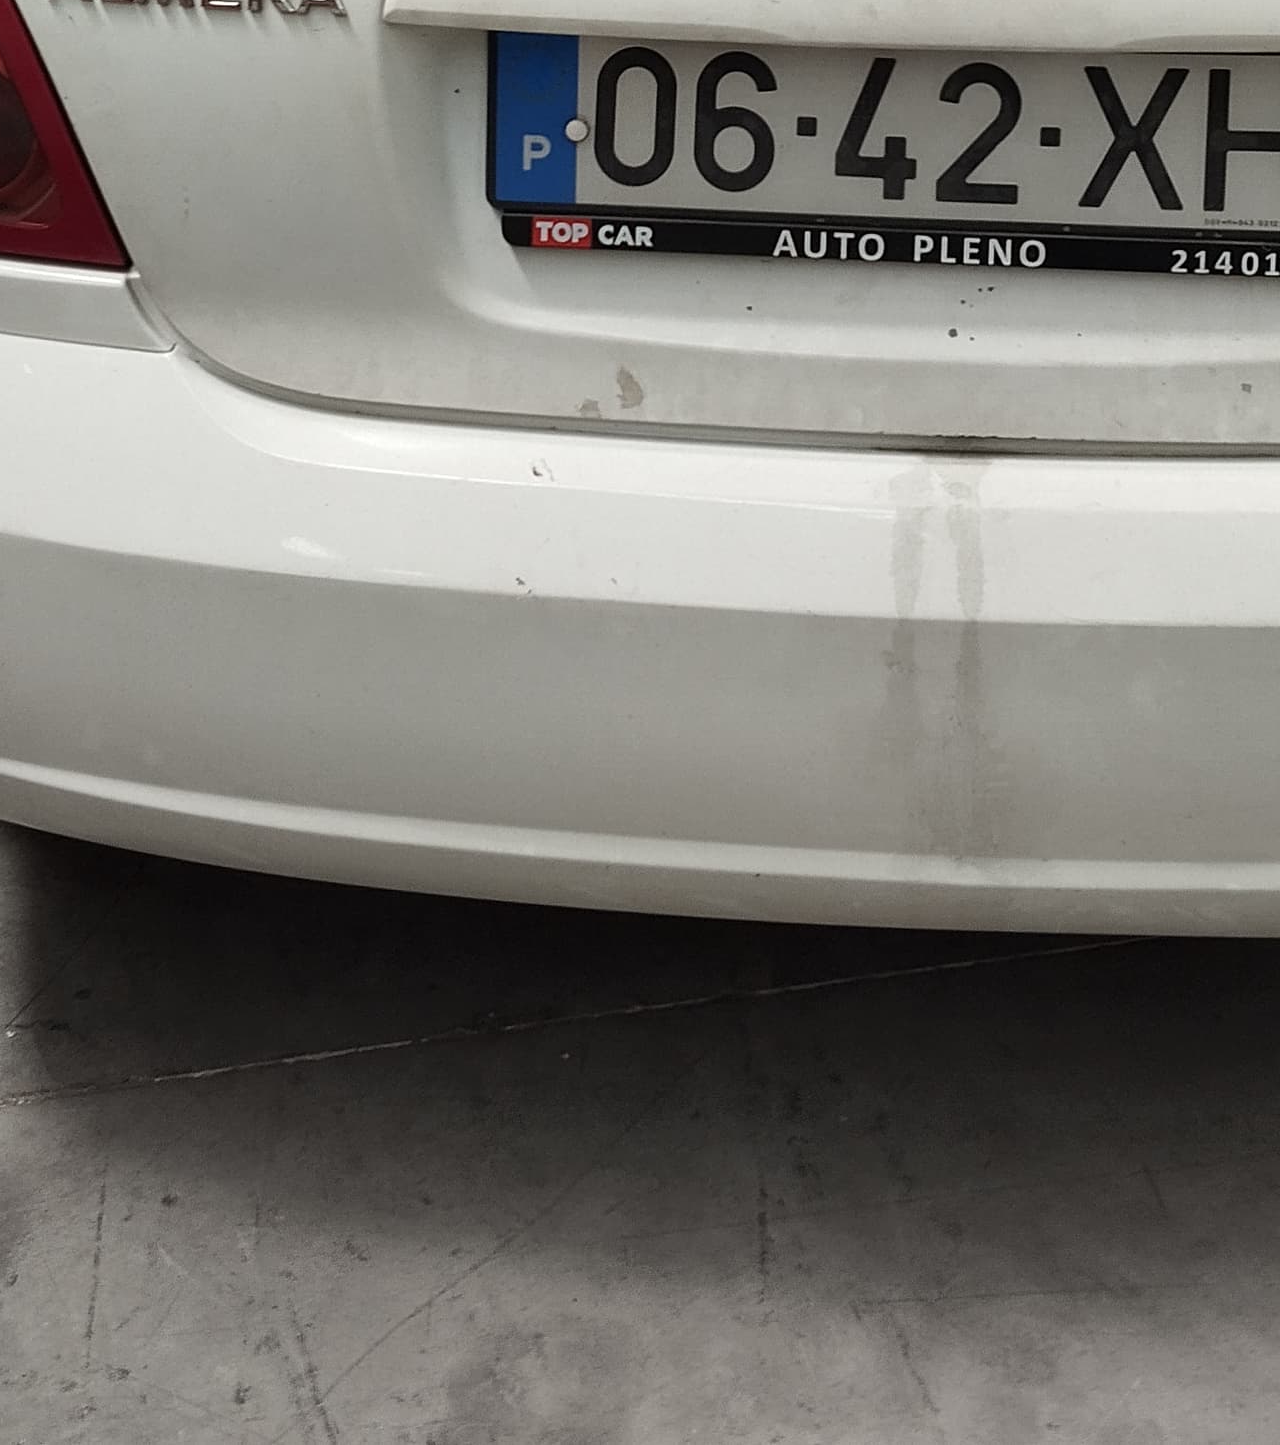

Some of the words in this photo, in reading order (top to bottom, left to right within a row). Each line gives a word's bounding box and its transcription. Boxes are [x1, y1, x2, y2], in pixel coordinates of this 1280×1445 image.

[522, 133, 552, 171] P
[535, 220, 589, 243] TOP
[597, 224, 654, 248] CAR
[772, 229, 888, 263] AUTO
[912, 234, 1048, 269] PLENO
